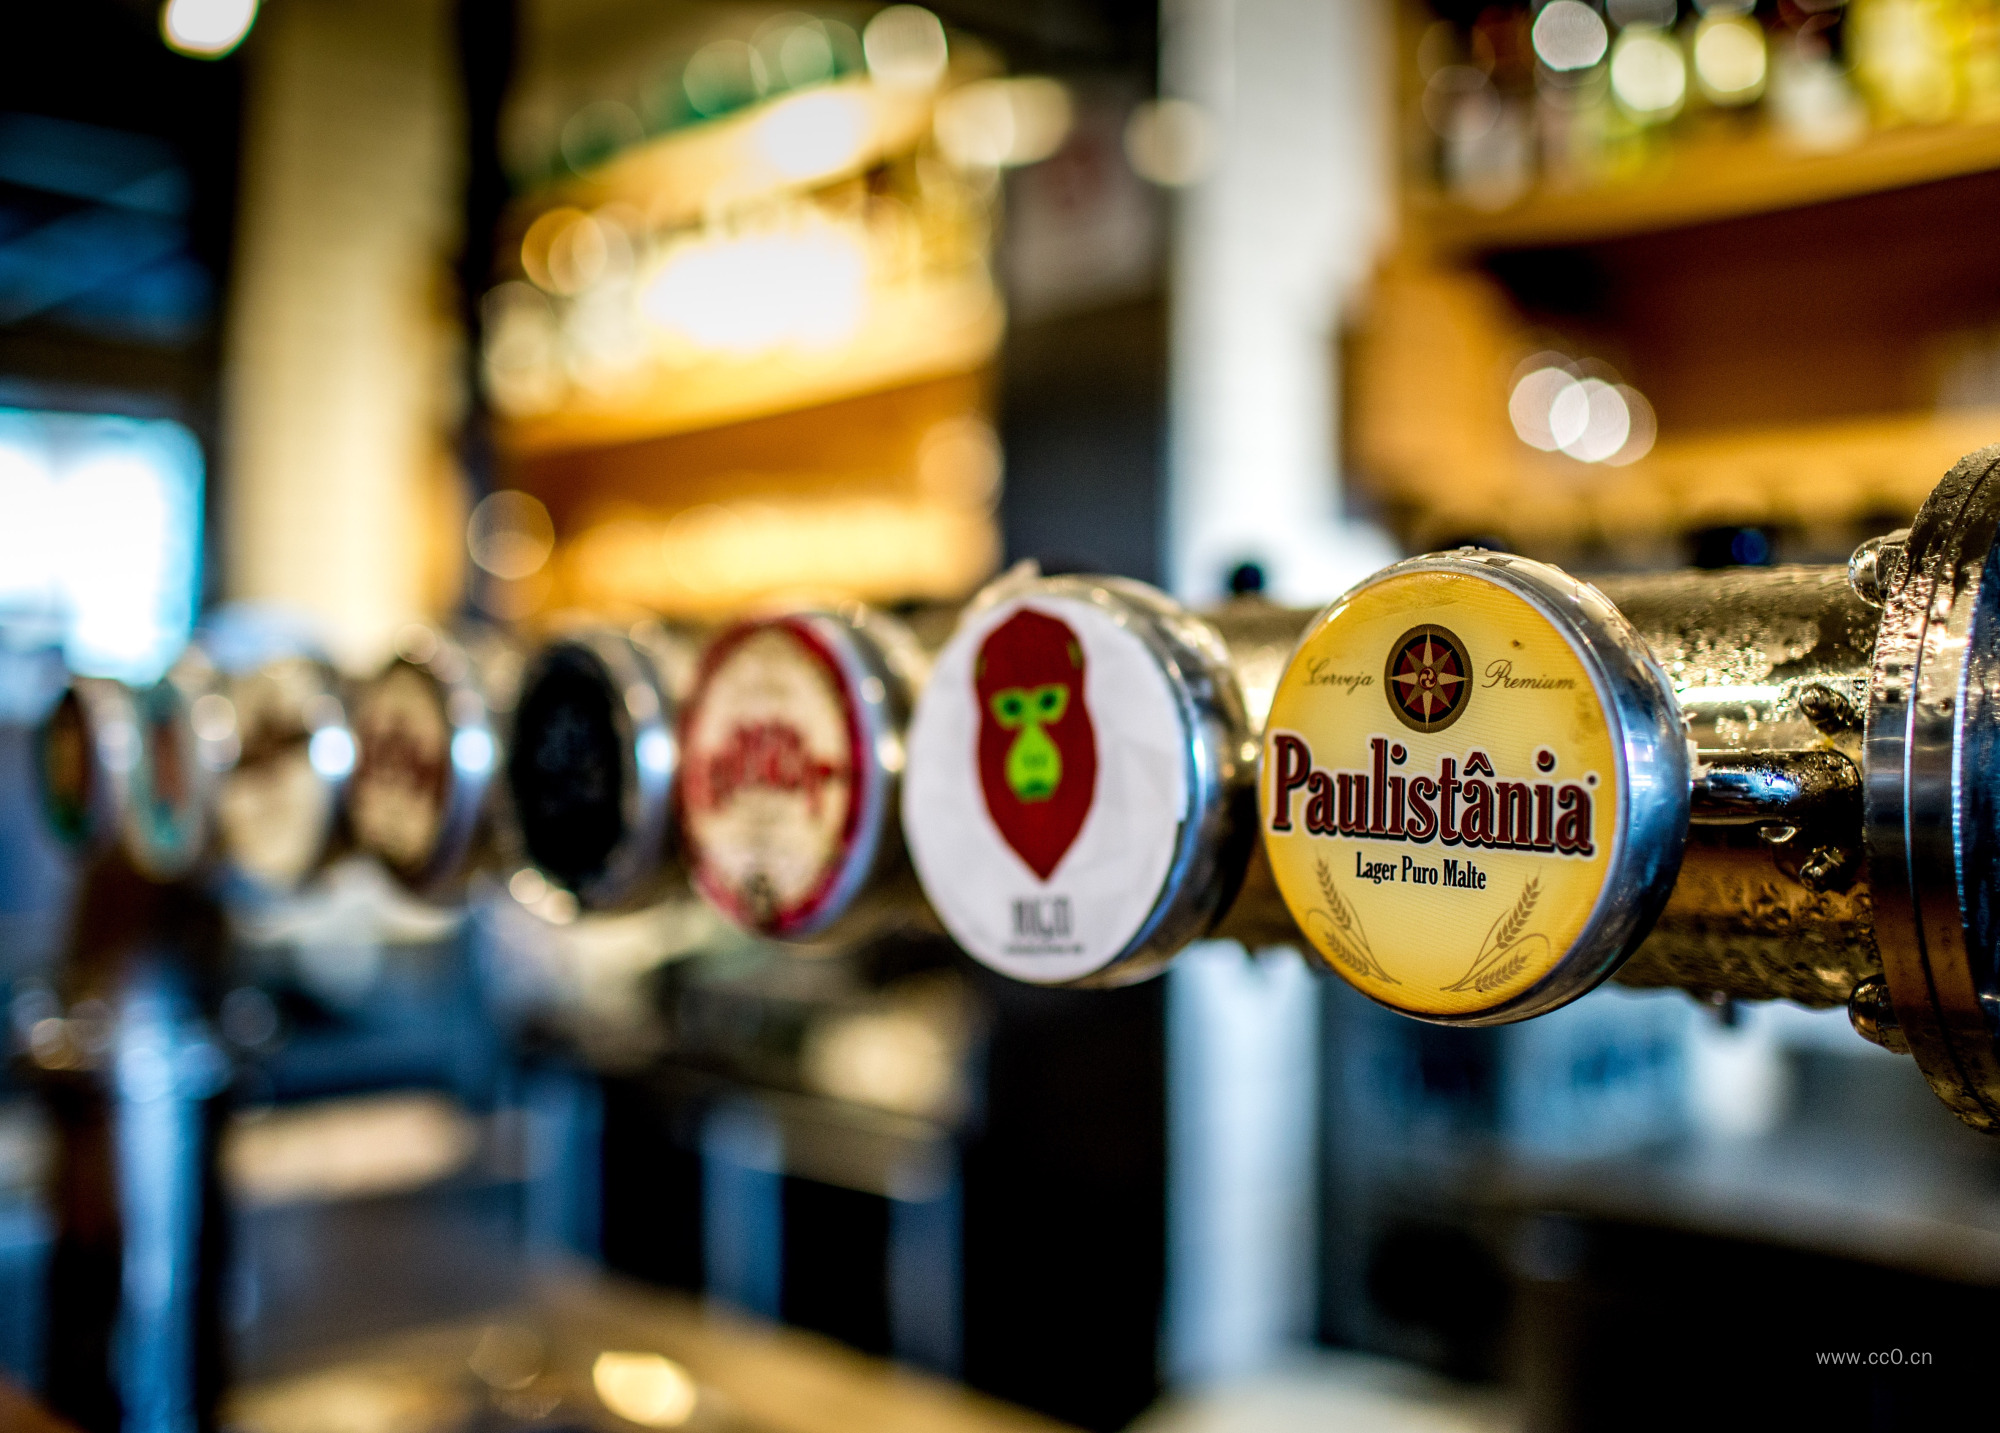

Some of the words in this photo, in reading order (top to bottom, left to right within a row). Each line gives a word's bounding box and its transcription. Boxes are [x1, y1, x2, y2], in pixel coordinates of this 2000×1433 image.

[1303, 657, 1374, 696] Cerveja
[1481, 659, 1577, 690] Premium
[1271, 735, 1596, 857] Paulistânia
[1356, 851, 1397, 884] Lager
[1401, 855, 1438, 885] Puro
[1442, 858, 1486, 889] Malte
